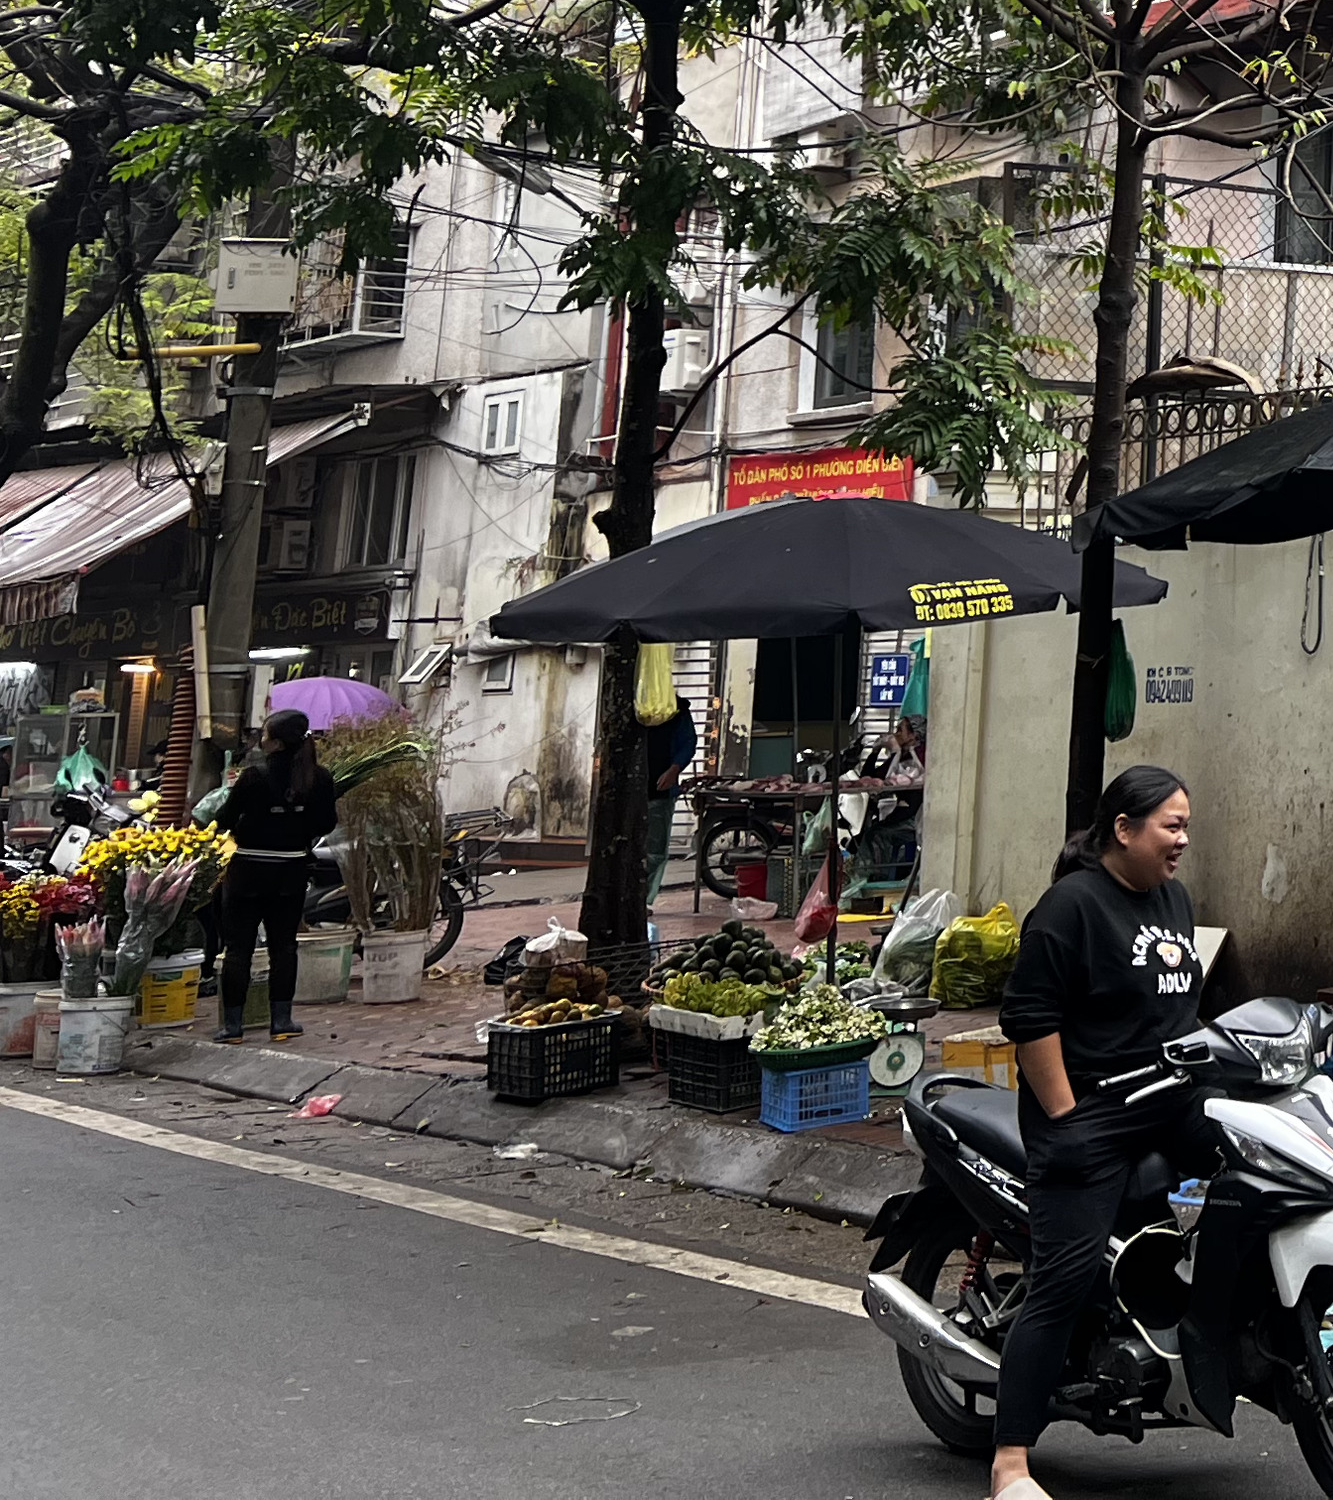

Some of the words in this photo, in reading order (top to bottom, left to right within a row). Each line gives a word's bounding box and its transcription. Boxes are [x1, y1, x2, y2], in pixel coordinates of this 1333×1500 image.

[768, 460, 789, 483] PHỐ
[789, 460, 804, 480] SỐ
[805, 465, 811, 479] 1
[812, 457, 854, 479] PHƯỜNG
[990, 594, 1014, 614] 335
[1157, 971, 1192, 995] ADLV
